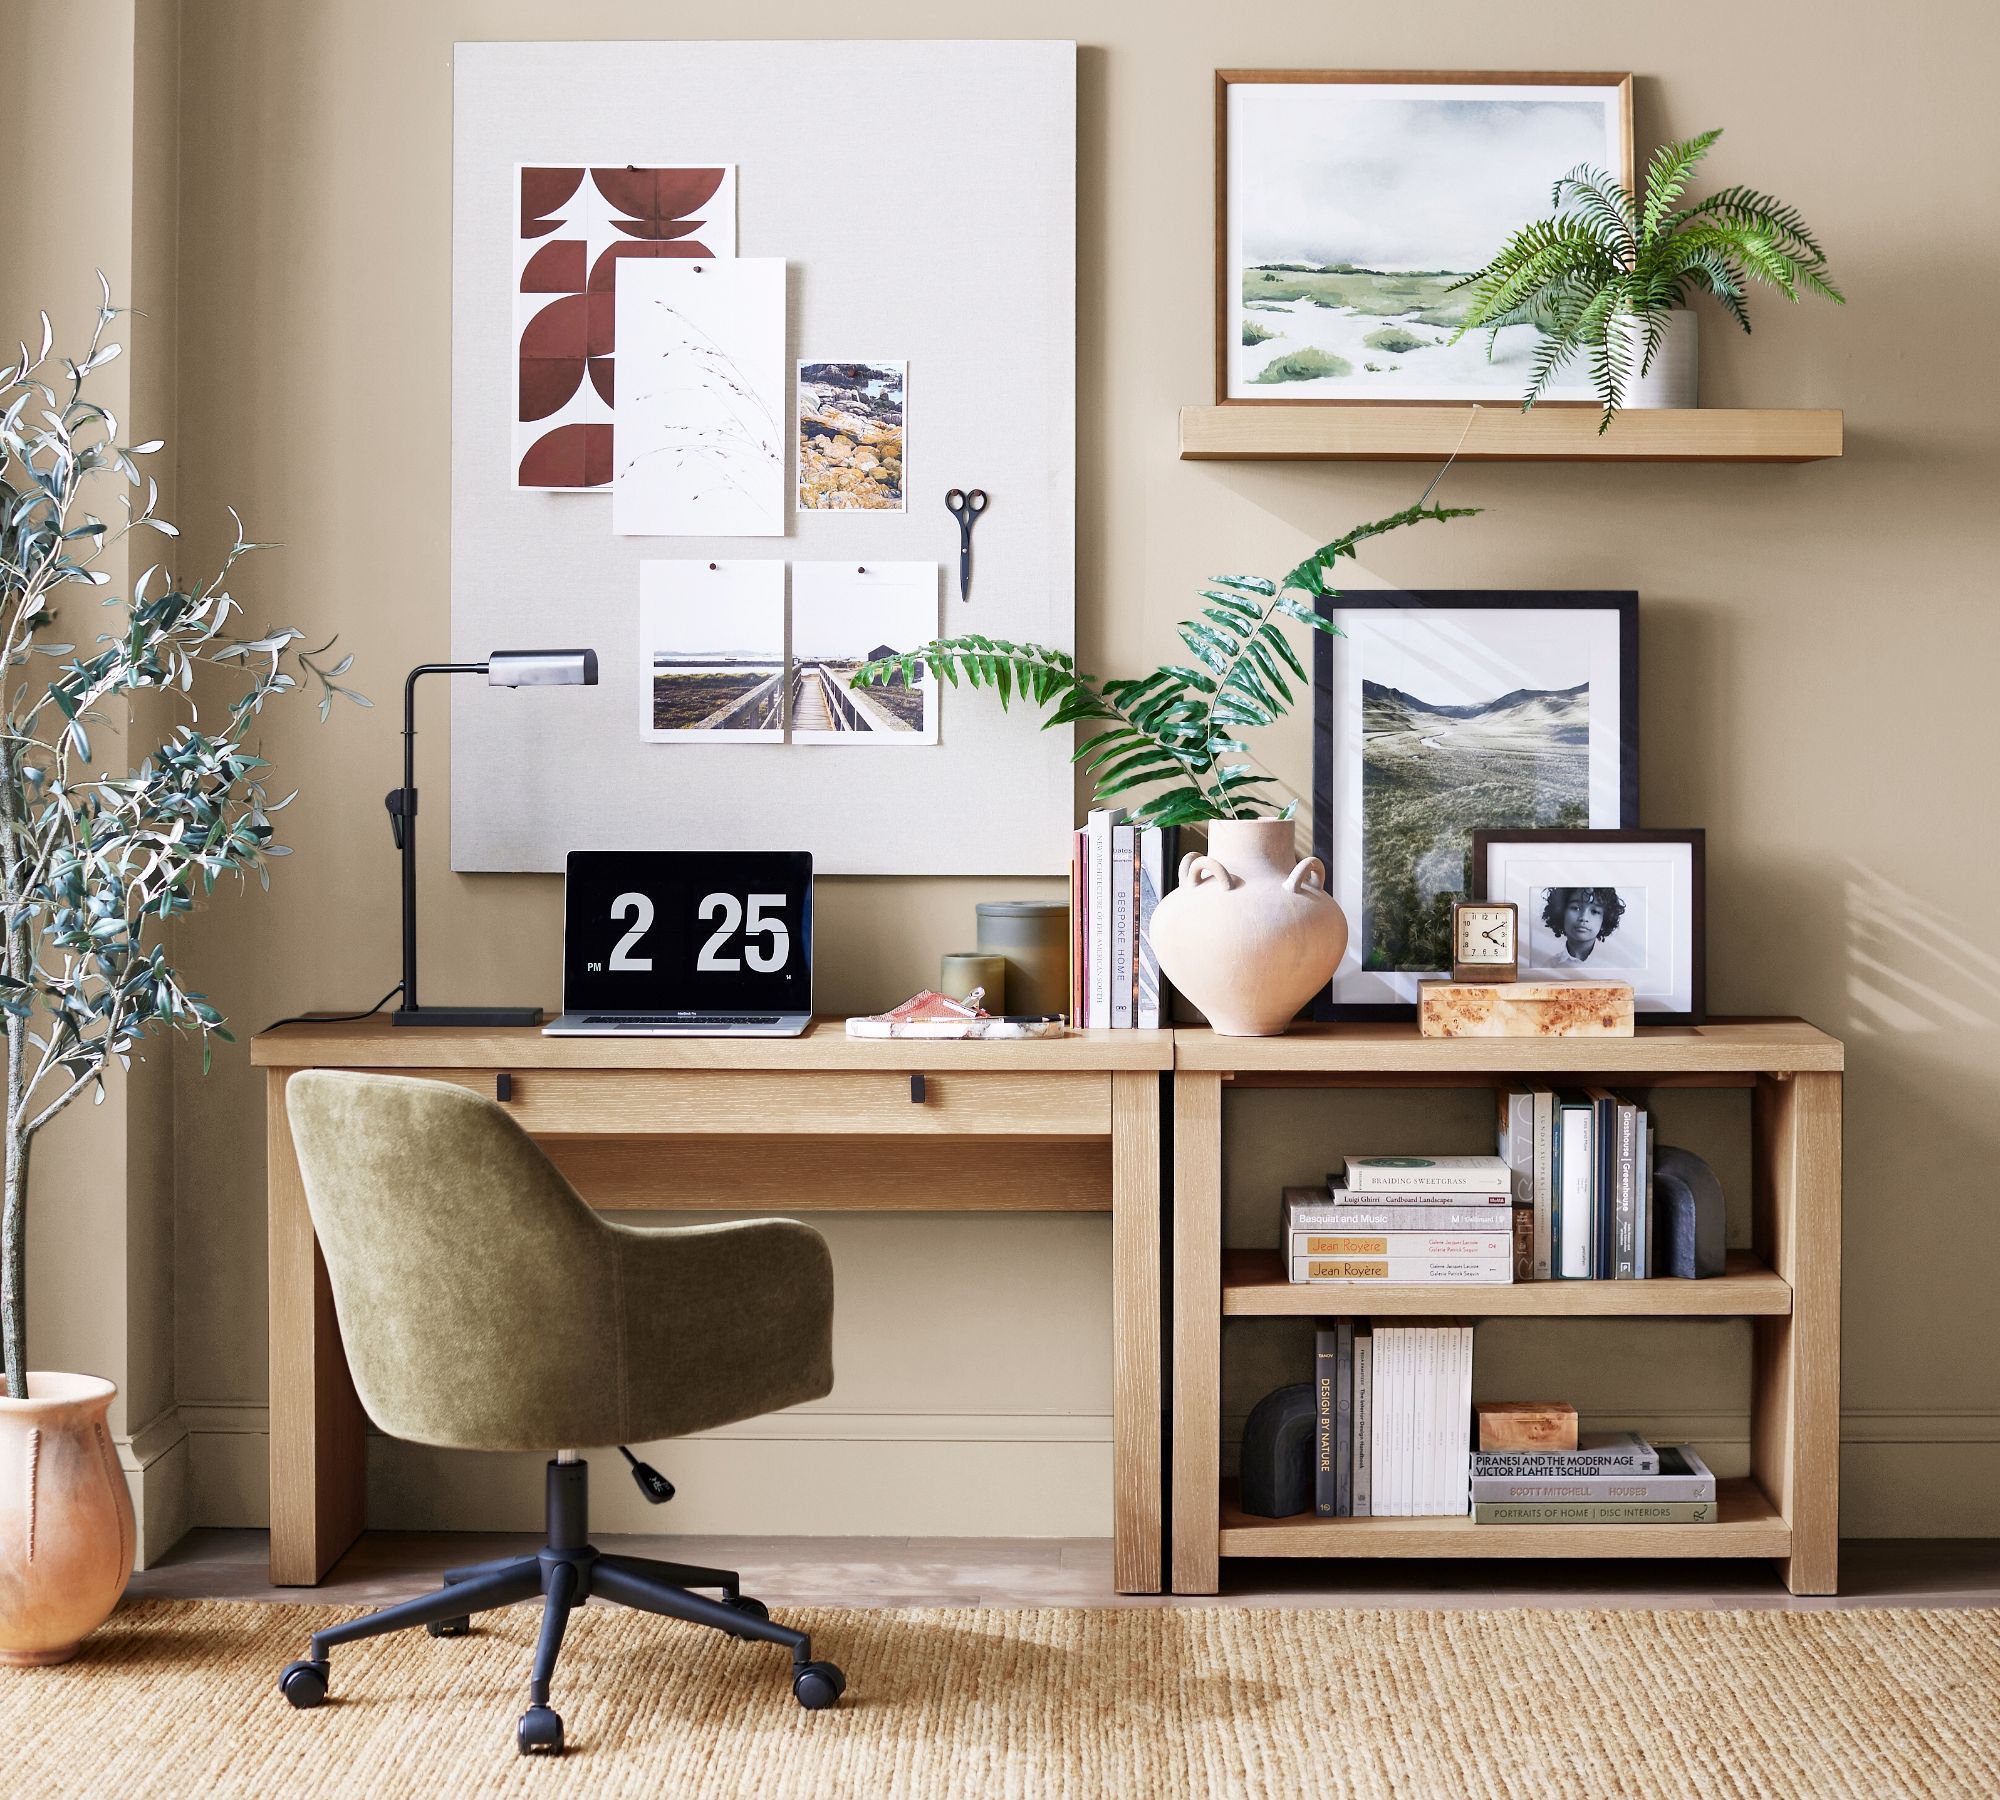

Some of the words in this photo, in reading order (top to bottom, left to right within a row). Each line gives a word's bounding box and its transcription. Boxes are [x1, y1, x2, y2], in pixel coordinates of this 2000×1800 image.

[1096, 912, 1103, 921] OF
[1117, 892, 1126, 944] BESPOKE
[609, 892, 654, 971] 2
[697, 892, 789, 972] 25
[587, 963, 601, 971] PM
[1117, 950, 1125, 981] HOME
[1623, 1112, 1631, 1157] Glasshouse
[1622, 1163, 1630, 1212] Greenhouse
[1344, 1196, 1359, 1204] Luigi
[1419, 1196, 1453, 1204] Landscapes
[1300, 1214, 1339, 1224] Basquiat
[1341, 1215, 1358, 1223] and
[1360, 1214, 1388, 1223] Music
[1313, 1239, 1337, 1251] Jean
[1343, 1239, 1380, 1253] Royère
[1314, 1263, 1339, 1276] Jean
[1345, 1263, 1381, 1277] Royère
[1321, 1378, 1329, 1415] DESIGN
[1321, 1418, 1329, 1431] BY
[1321, 1433, 1329, 1472] NATURE
[1476, 1456, 1520, 1466] PIRANESI
[1522, 1456, 1544, 1466] AND
[1547, 1456, 1565, 1466] THE
[1567, 1456, 1611, 1466] MODERN
[1612, 1456, 1634, 1466] AGE
[1476, 1467, 1514, 1476] VICTOR
[1516, 1467, 1555, 1476] PLAHTE
[1556, 1467, 1600, 1476] TSCHUDI
[1510, 1487, 1542, 1496] SCOTT
[1544, 1487, 1592, 1496] MITCHELL
[1609, 1487, 1648, 1496] HOUSES
[1494, 1509, 1542, 1518] PORTRAITS
[1545, 1509, 1558, 1518] OF
[1560, 1509, 1588, 1518] HOME
[1600, 1509, 1622, 1517] DISC
[1624, 1509, 1671, 1517] INTERIORS
